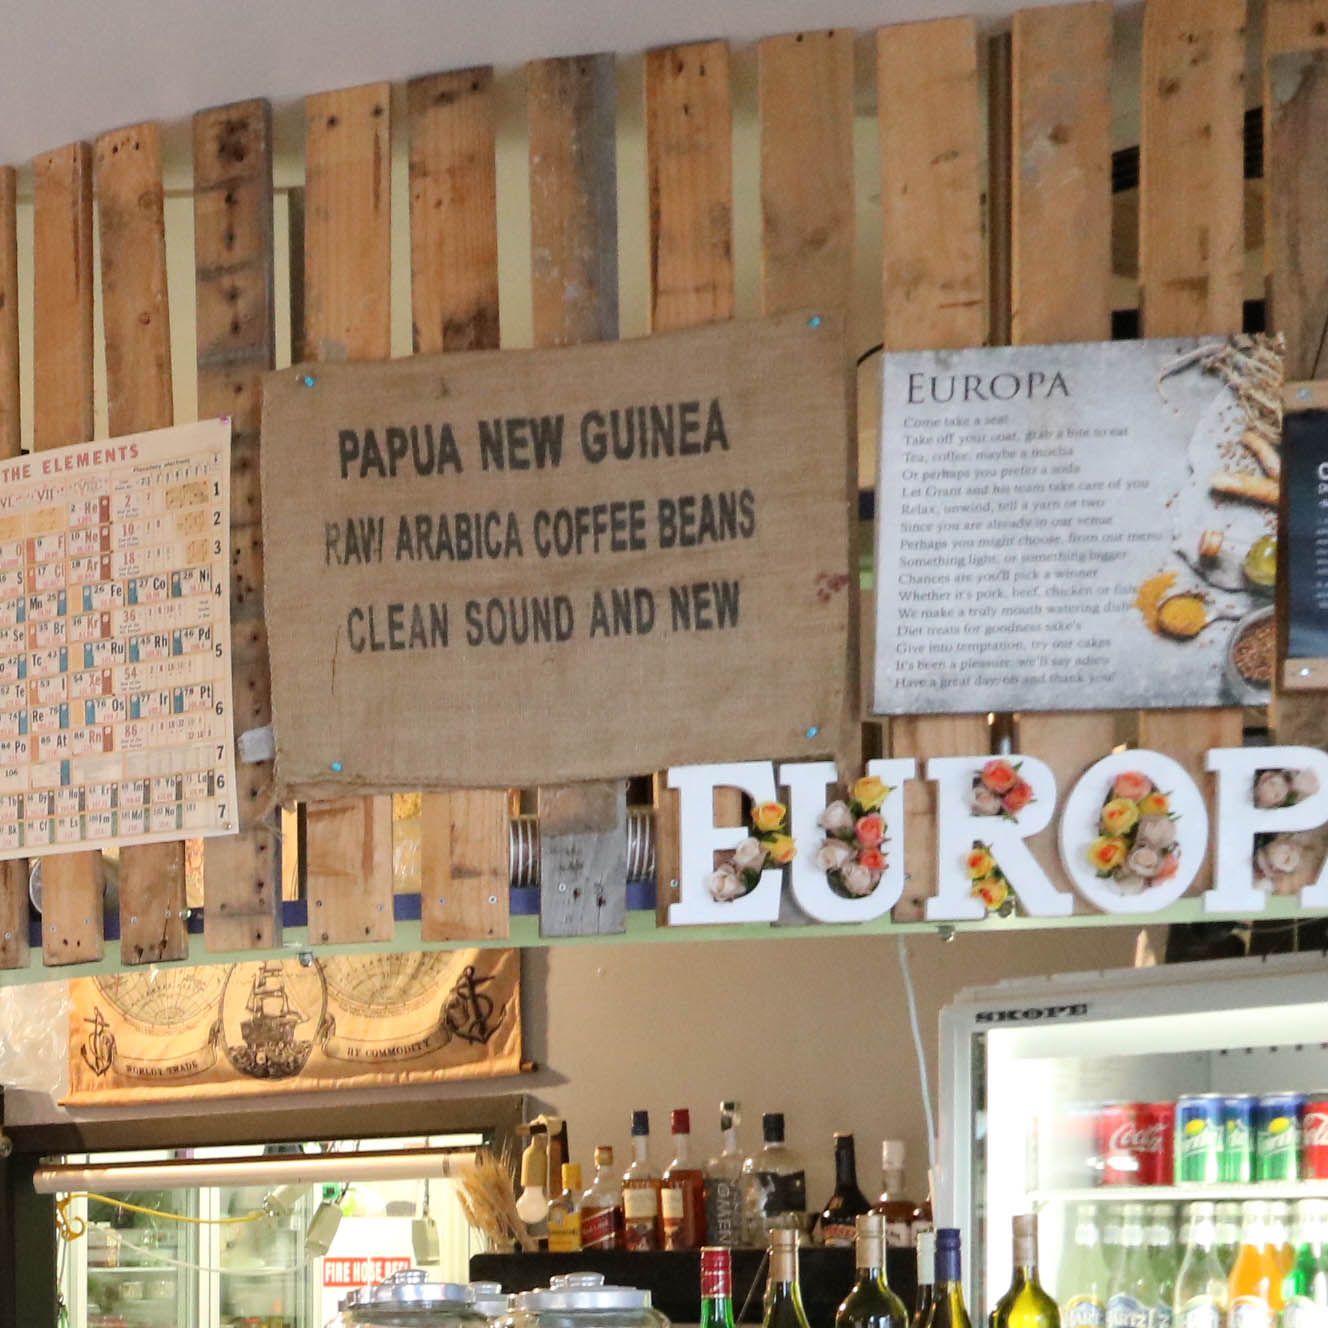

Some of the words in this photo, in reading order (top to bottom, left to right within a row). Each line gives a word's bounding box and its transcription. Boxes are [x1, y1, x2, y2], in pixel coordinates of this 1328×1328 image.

[907, 371, 1070, 405] EUROPA
[3, 464, 31, 482] THE
[43, 444, 139, 473] ELEMENTS
[339, 422, 464, 479] PAPUA
[478, 414, 564, 471] NEW
[580, 398, 730, 464] GUINEA
[325, 516, 384, 567] RAW
[395, 511, 523, 563] ARABICA
[533, 501, 647, 558] COFFEE
[657, 489, 756, 549] BEANS
[347, 602, 449, 653] CLEAN
[465, 594, 574, 648] SOUND
[589, 586, 655, 636] AND
[670, 581, 741, 632] NEW
[668, 747, 1328, 925] EUROP
[975, 1004, 1089, 1023] SKOPE
[325, 1261, 350, 1283] FIRE
